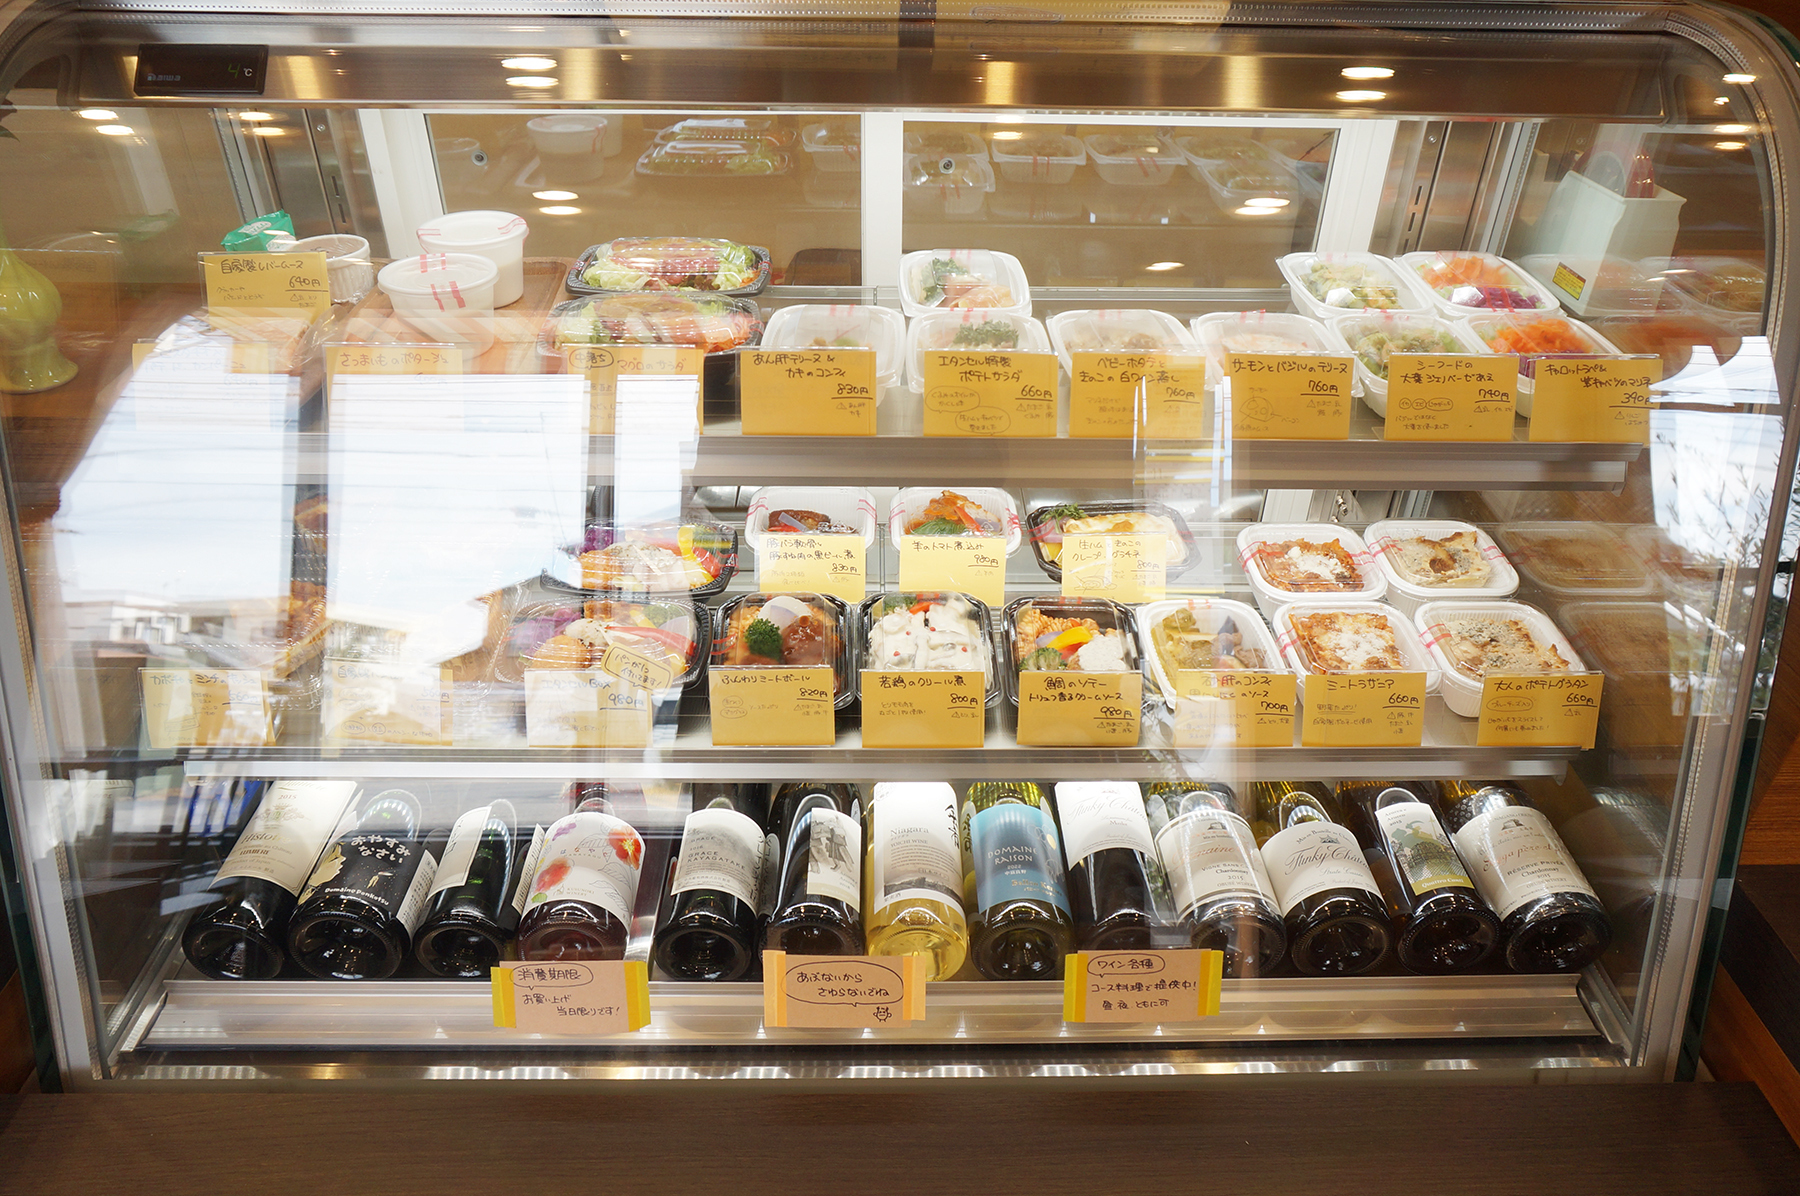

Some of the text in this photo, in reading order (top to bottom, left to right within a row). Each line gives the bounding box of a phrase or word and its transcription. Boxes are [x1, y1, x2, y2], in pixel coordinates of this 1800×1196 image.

[228, 63, 241, 79] 4
[220, 258, 304, 274] 自家製レバームース
[288, 275, 321, 288] 640円
[339, 352, 449, 368] さつまいものポタージュ
[617, 357, 687, 371] マグロのサラダ
[753, 353, 822, 366] あん肝テリーヌ
[938, 354, 1013, 368] エタンセル特製
[1098, 356, 1166, 370] ベビーホタテと
[1231, 358, 1349, 374] サーモンとバジルのテリーヌ
[1416, 360, 1474, 371] シーフードの
[785, 366, 847, 378] カキのコンフィ
[958, 369, 1023, 383] ポテトサラダ
[836, 383, 869, 396] 830円
[1020, 384, 1053, 398] 660円
[1165, 386, 1196, 400] 760円
[1308, 379, 1339, 394] 760円
[1478, 388, 1510, 401] 740円
[973, 553, 999, 565] 980円
[1136, 559, 1160, 569] 800円
[831, 562, 858, 573] 830円
[721, 673, 811, 685] ふんわりミートボール
[1043, 677, 1107, 690] 鯛のソテー
[1327, 679, 1395, 690] ミートラザニア
[1493, 679, 1590, 692] 大人のポテトグラタン
[799, 687, 828, 698] 820円
[949, 692, 979, 706] 800円
[1388, 692, 1420, 705] 660円
[1565, 692, 1595, 705] 660円
[607, 692, 644, 708] 980円
[1260, 700, 1289, 713] 700円
[1099, 706, 1133, 719] 980円
[890, 826, 930, 837] Niagara
[351, 834, 411, 857] おやすみ
[987, 845, 1038, 859] DOMAINE
[358, 845, 403, 864] なさい
[687, 850, 719, 858] GRACE
[994, 854, 1033, 865] RAISON
[1521, 867, 1560, 878] Chardonnay
[1097, 958, 1154, 970] ワイン各種
[517, 968, 582, 982] 消費期限
[796, 971, 864, 985] あぶないから
[817, 986, 891, 999] さわらないでね
[1091, 979, 1197, 993] コース料理で提供中!
[521, 993, 572, 1005] お買い上げ
[556, 1005, 622, 1017] 当日限りです!
